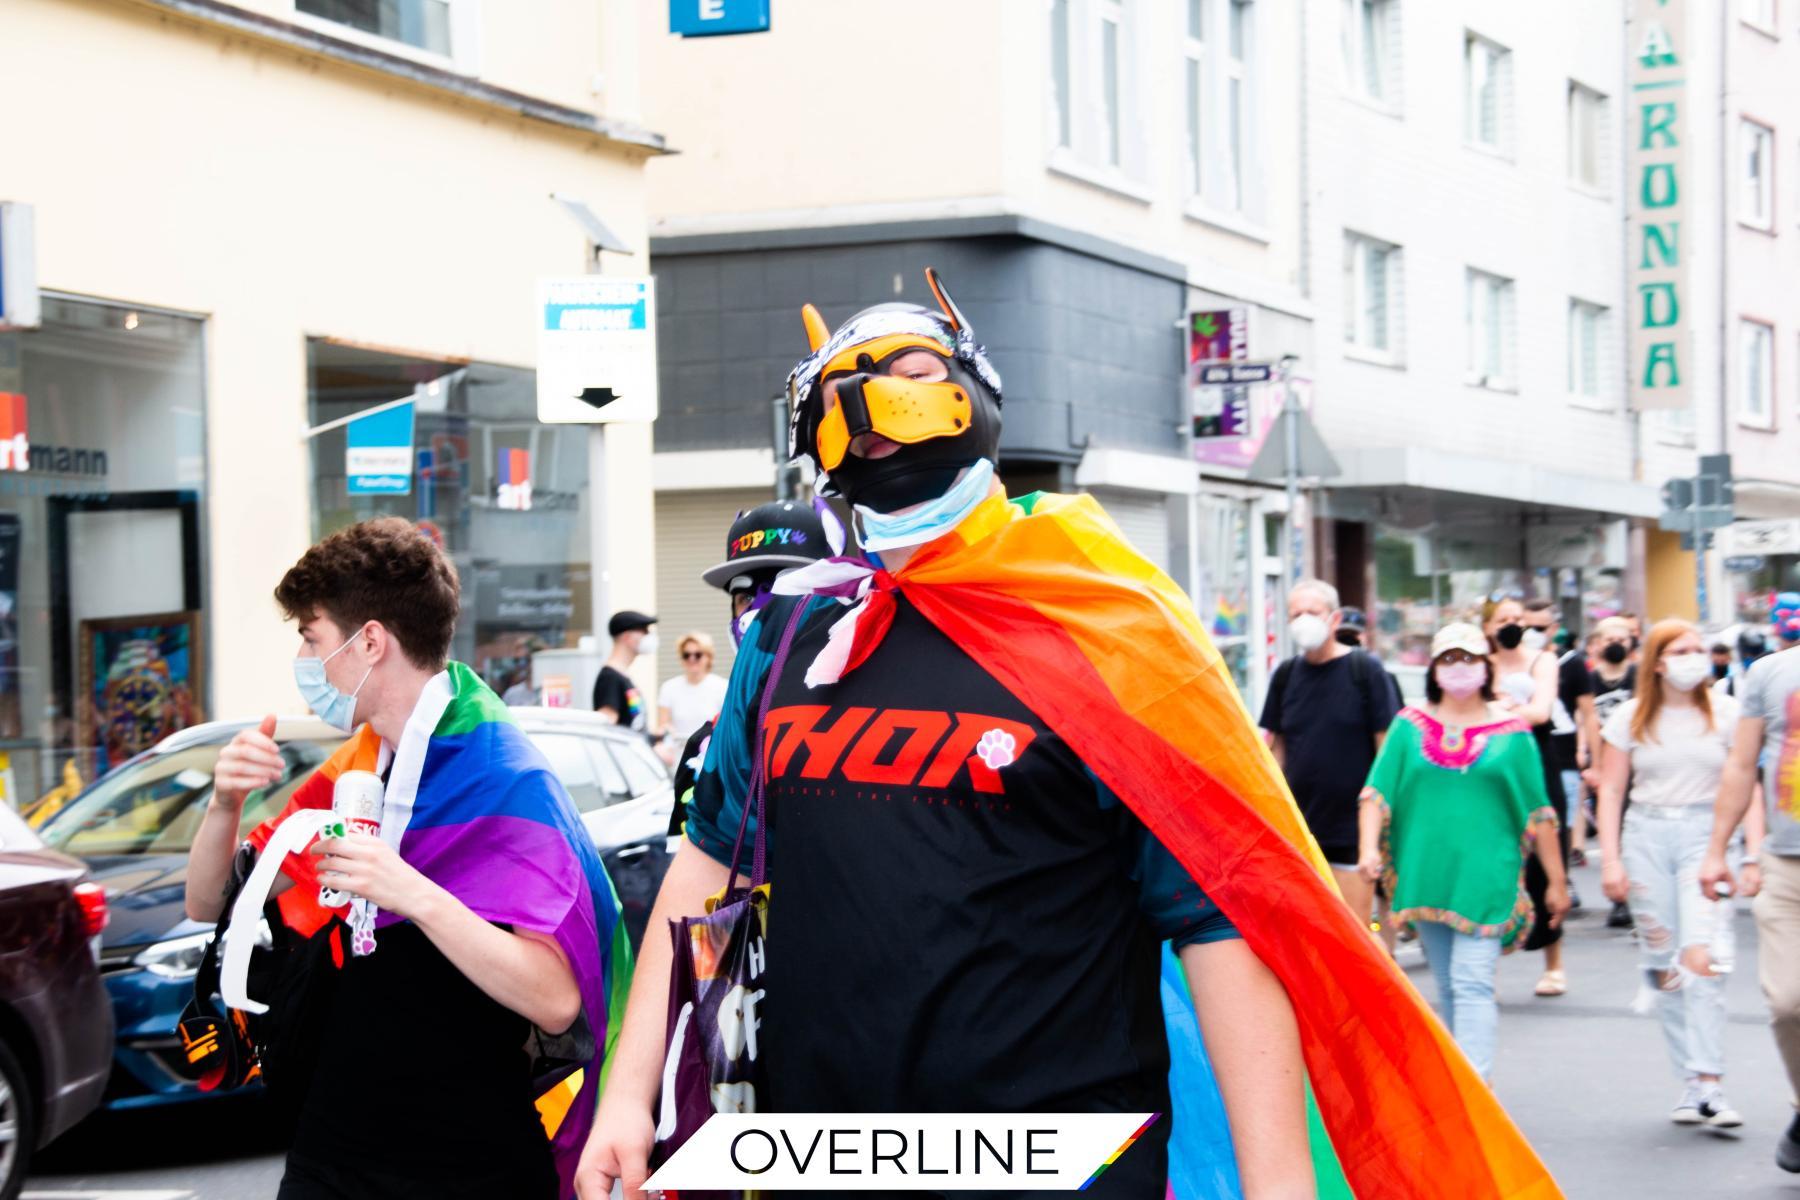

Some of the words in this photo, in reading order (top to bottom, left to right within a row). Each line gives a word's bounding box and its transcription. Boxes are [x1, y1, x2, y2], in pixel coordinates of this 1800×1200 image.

[1637, 102, 1681, 389] RONDA
[730, 528, 793, 558] PUPPY
[763, 705, 1038, 794] THOR
